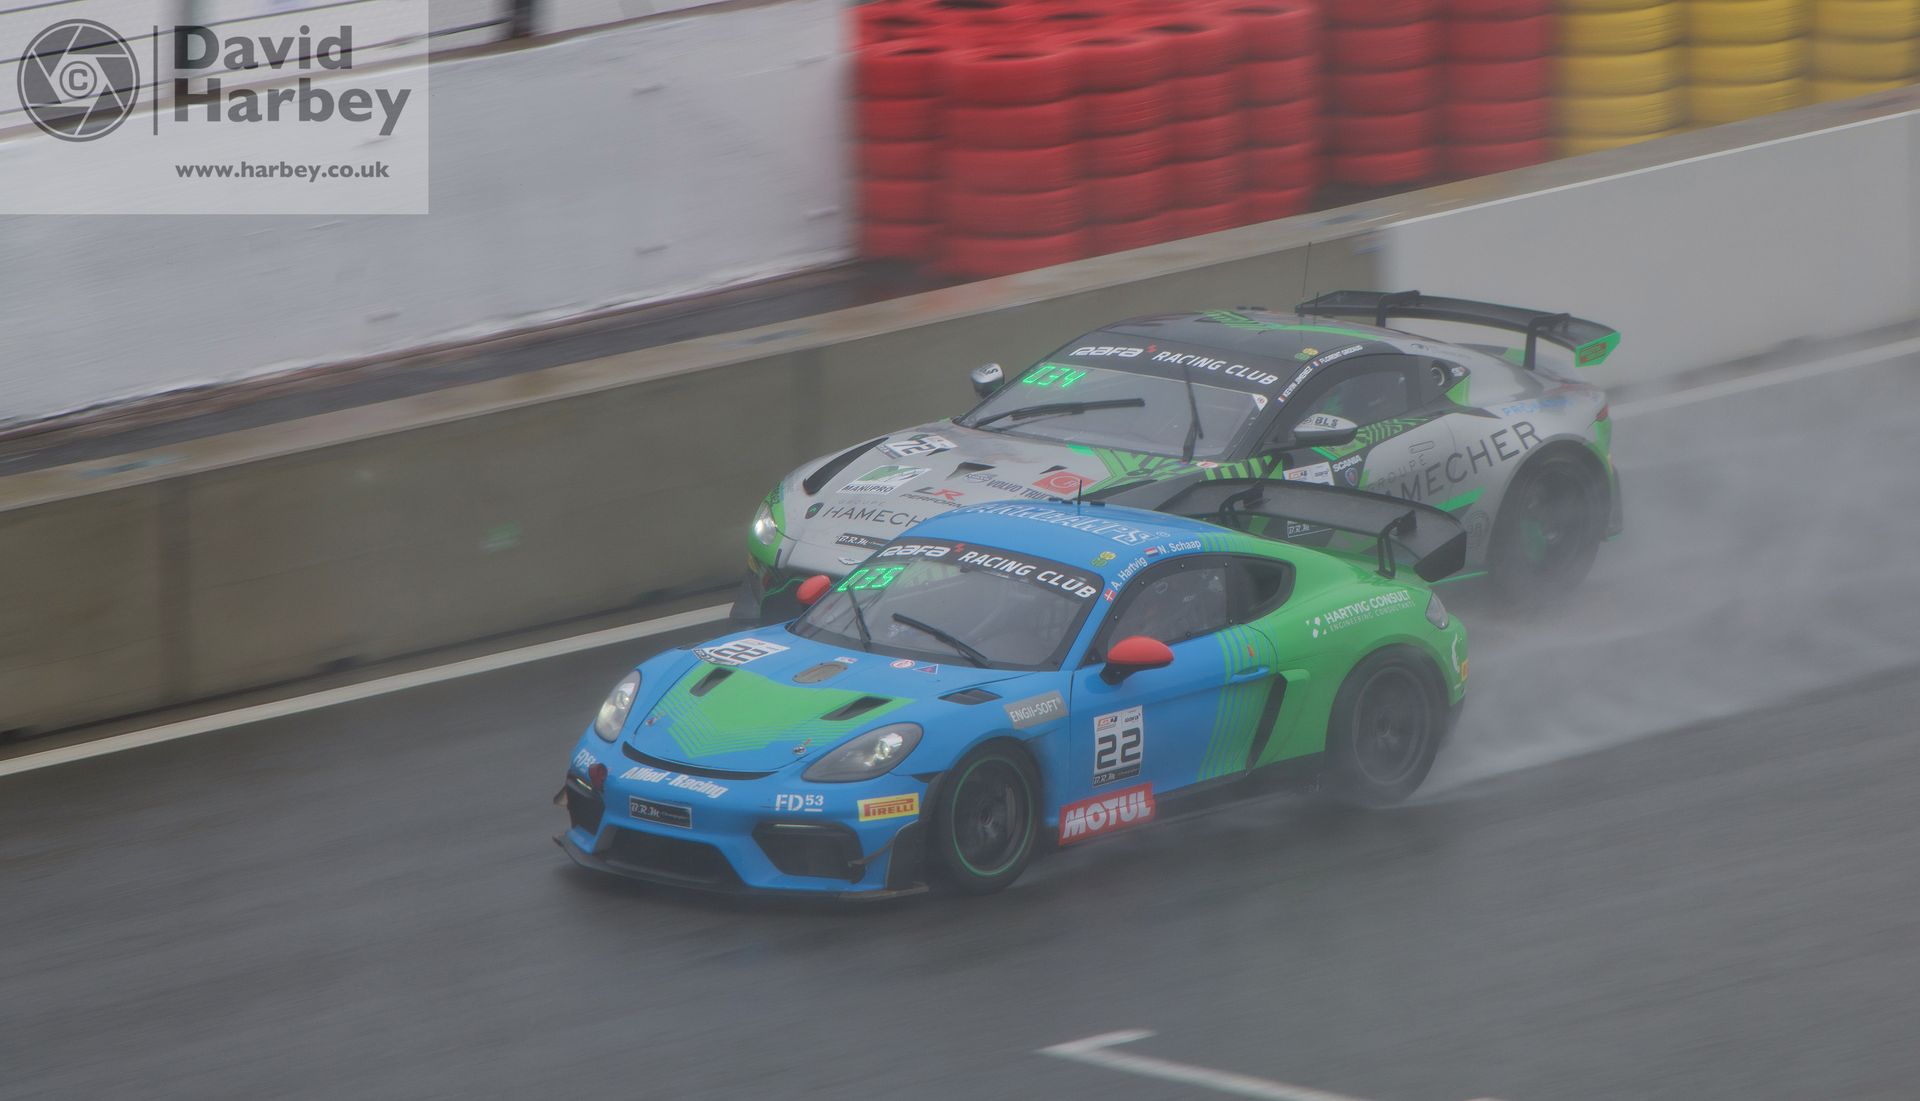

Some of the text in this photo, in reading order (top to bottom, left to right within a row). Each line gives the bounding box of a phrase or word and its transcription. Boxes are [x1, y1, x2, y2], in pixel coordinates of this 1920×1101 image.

[1151, 350, 1226, 371] RACING
[1226, 364, 1279, 386] CLUB
[1315, 416, 1338, 428] BLS
[1332, 454, 1363, 472] SCANIA
[986, 479, 1023, 493] VOLVO
[1157, 539, 1202, 555] N. Schaap
[958, 551, 1036, 576] RACING
[1036, 570, 1097, 599] CLUB
[1111, 556, 1148, 591] A. Hartvig
[1323, 590, 1410, 624] HARTVIG CONSULT
[1097, 727, 1141, 770] 22
[863, 796, 915, 818] PIRELLI
[1063, 790, 1151, 839] MOTUL
